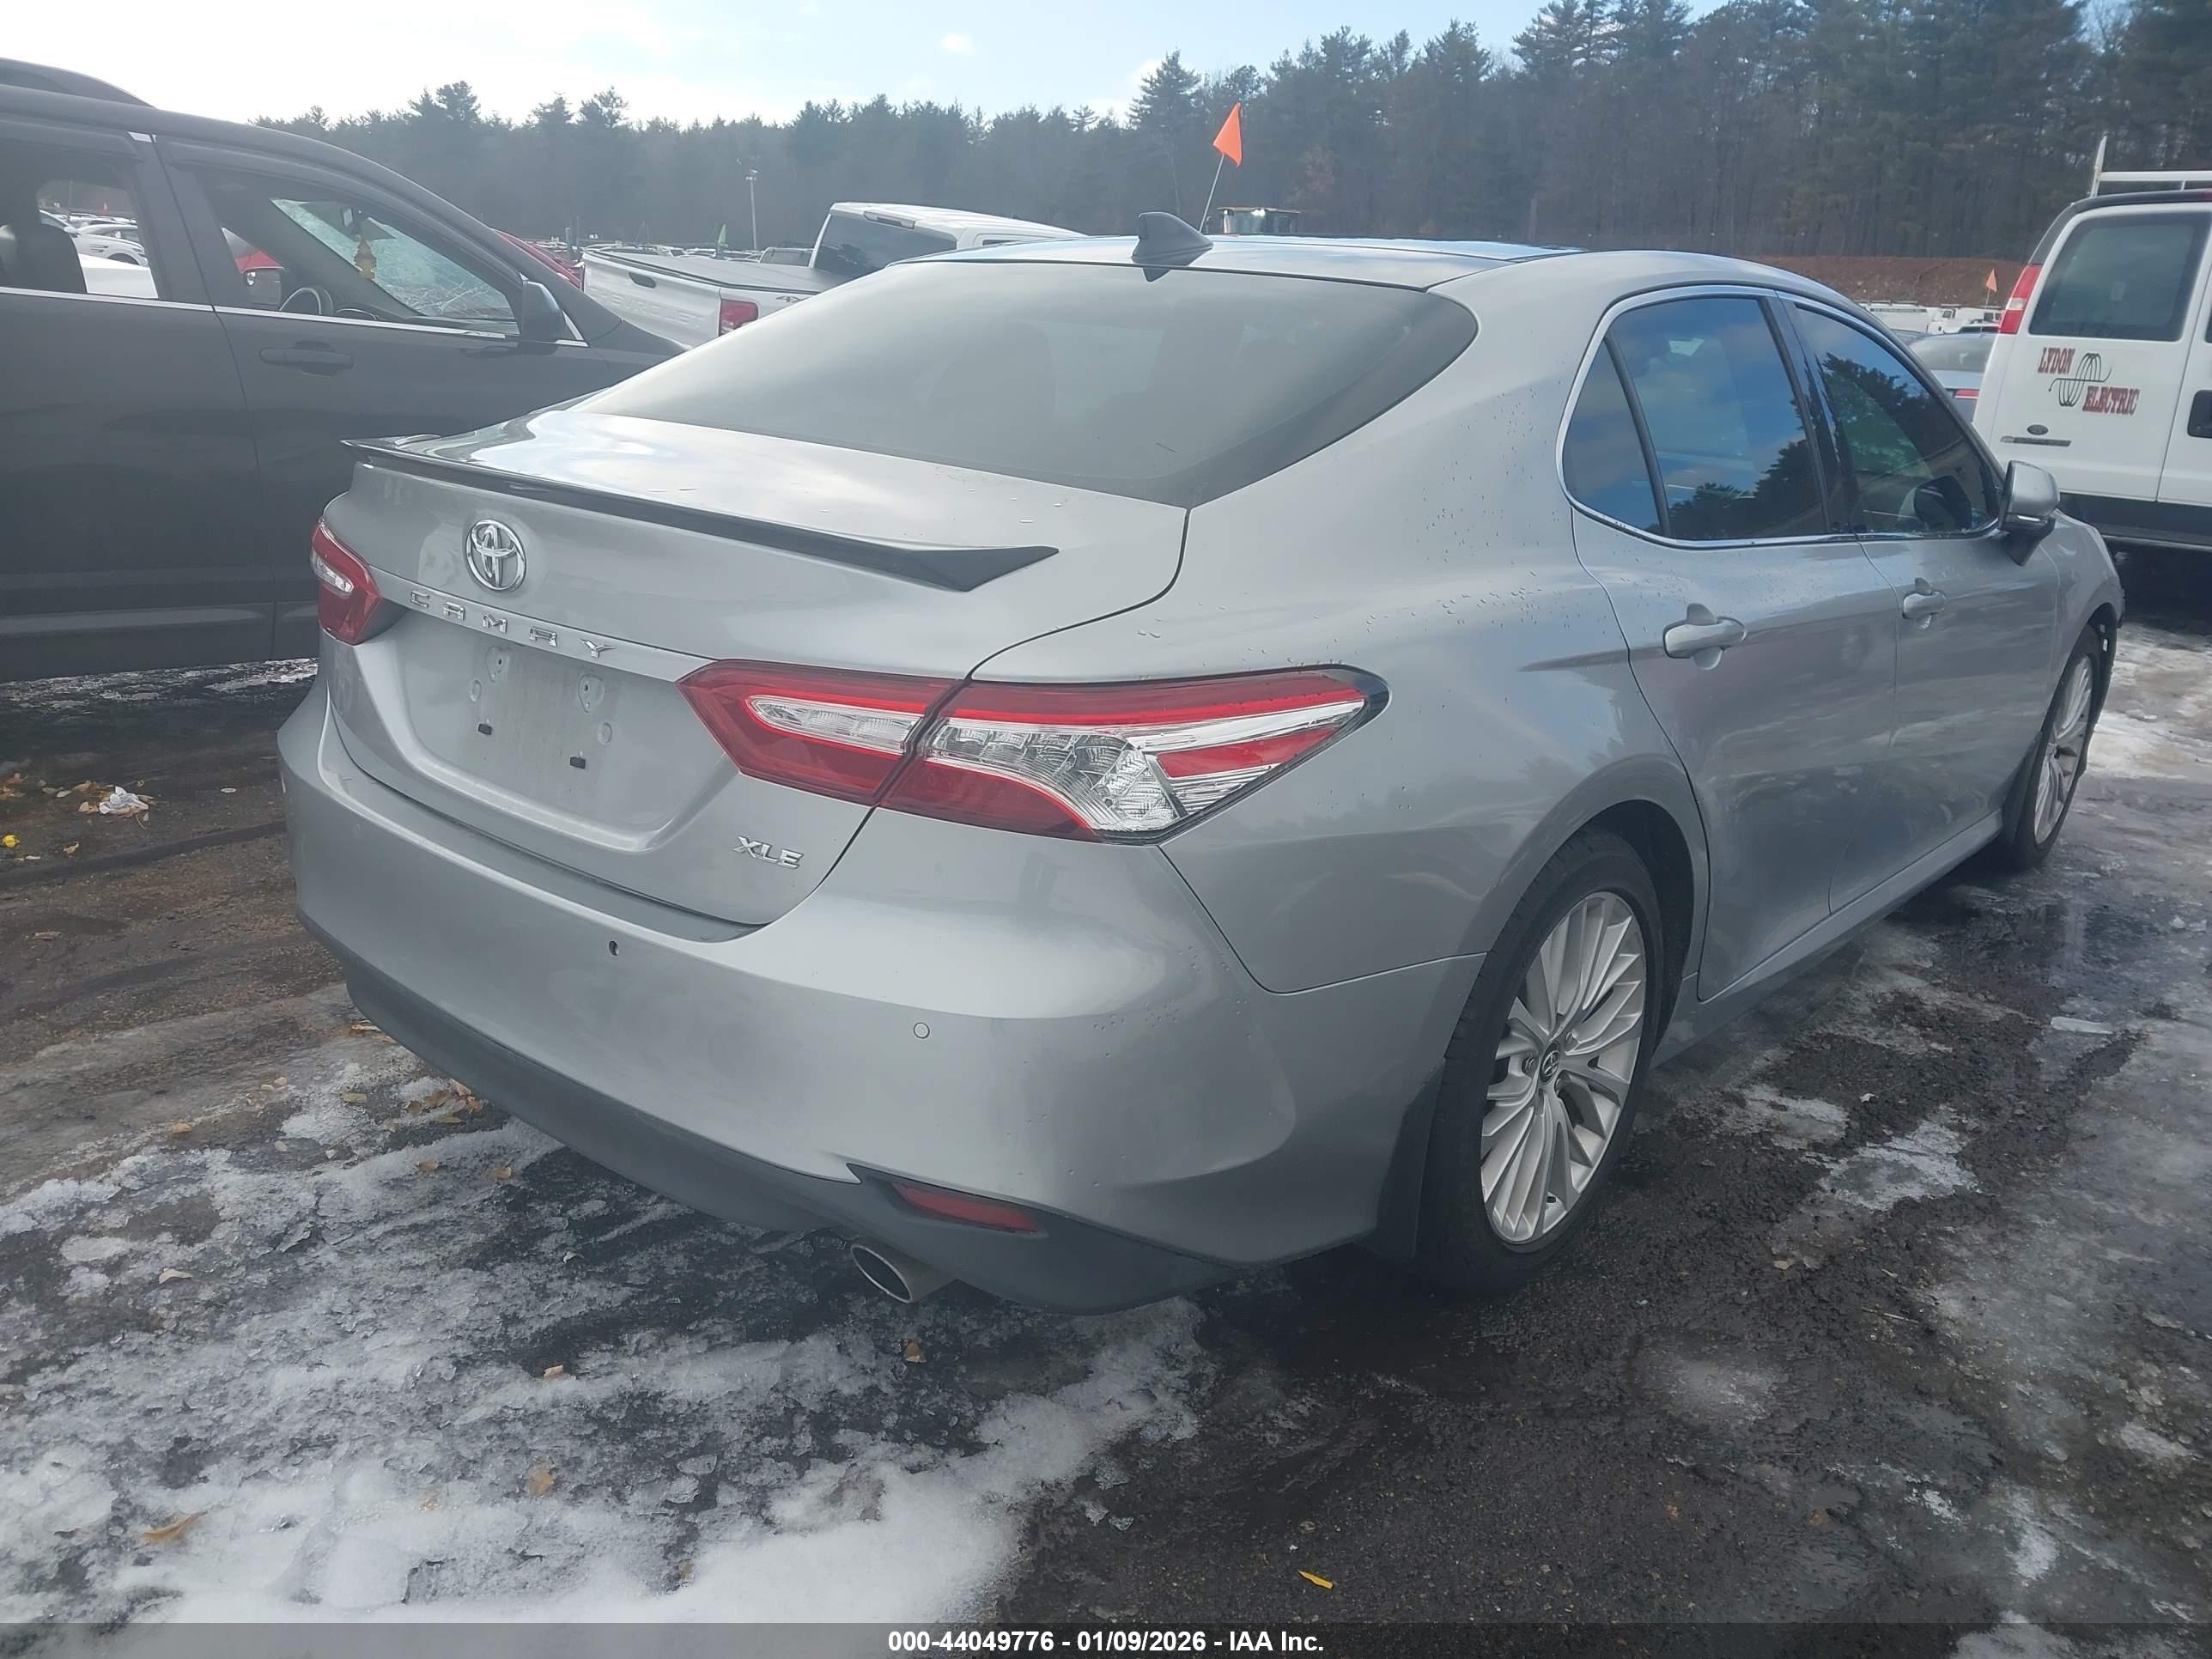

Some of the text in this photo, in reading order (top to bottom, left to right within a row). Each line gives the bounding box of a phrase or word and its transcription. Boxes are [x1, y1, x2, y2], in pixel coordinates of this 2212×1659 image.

[2038, 347, 2075, 374] LYDON
[2082, 386, 2140, 416] ELECTRIC
[410, 590, 617, 659] CAMRY
[731, 835, 804, 870] XLE
